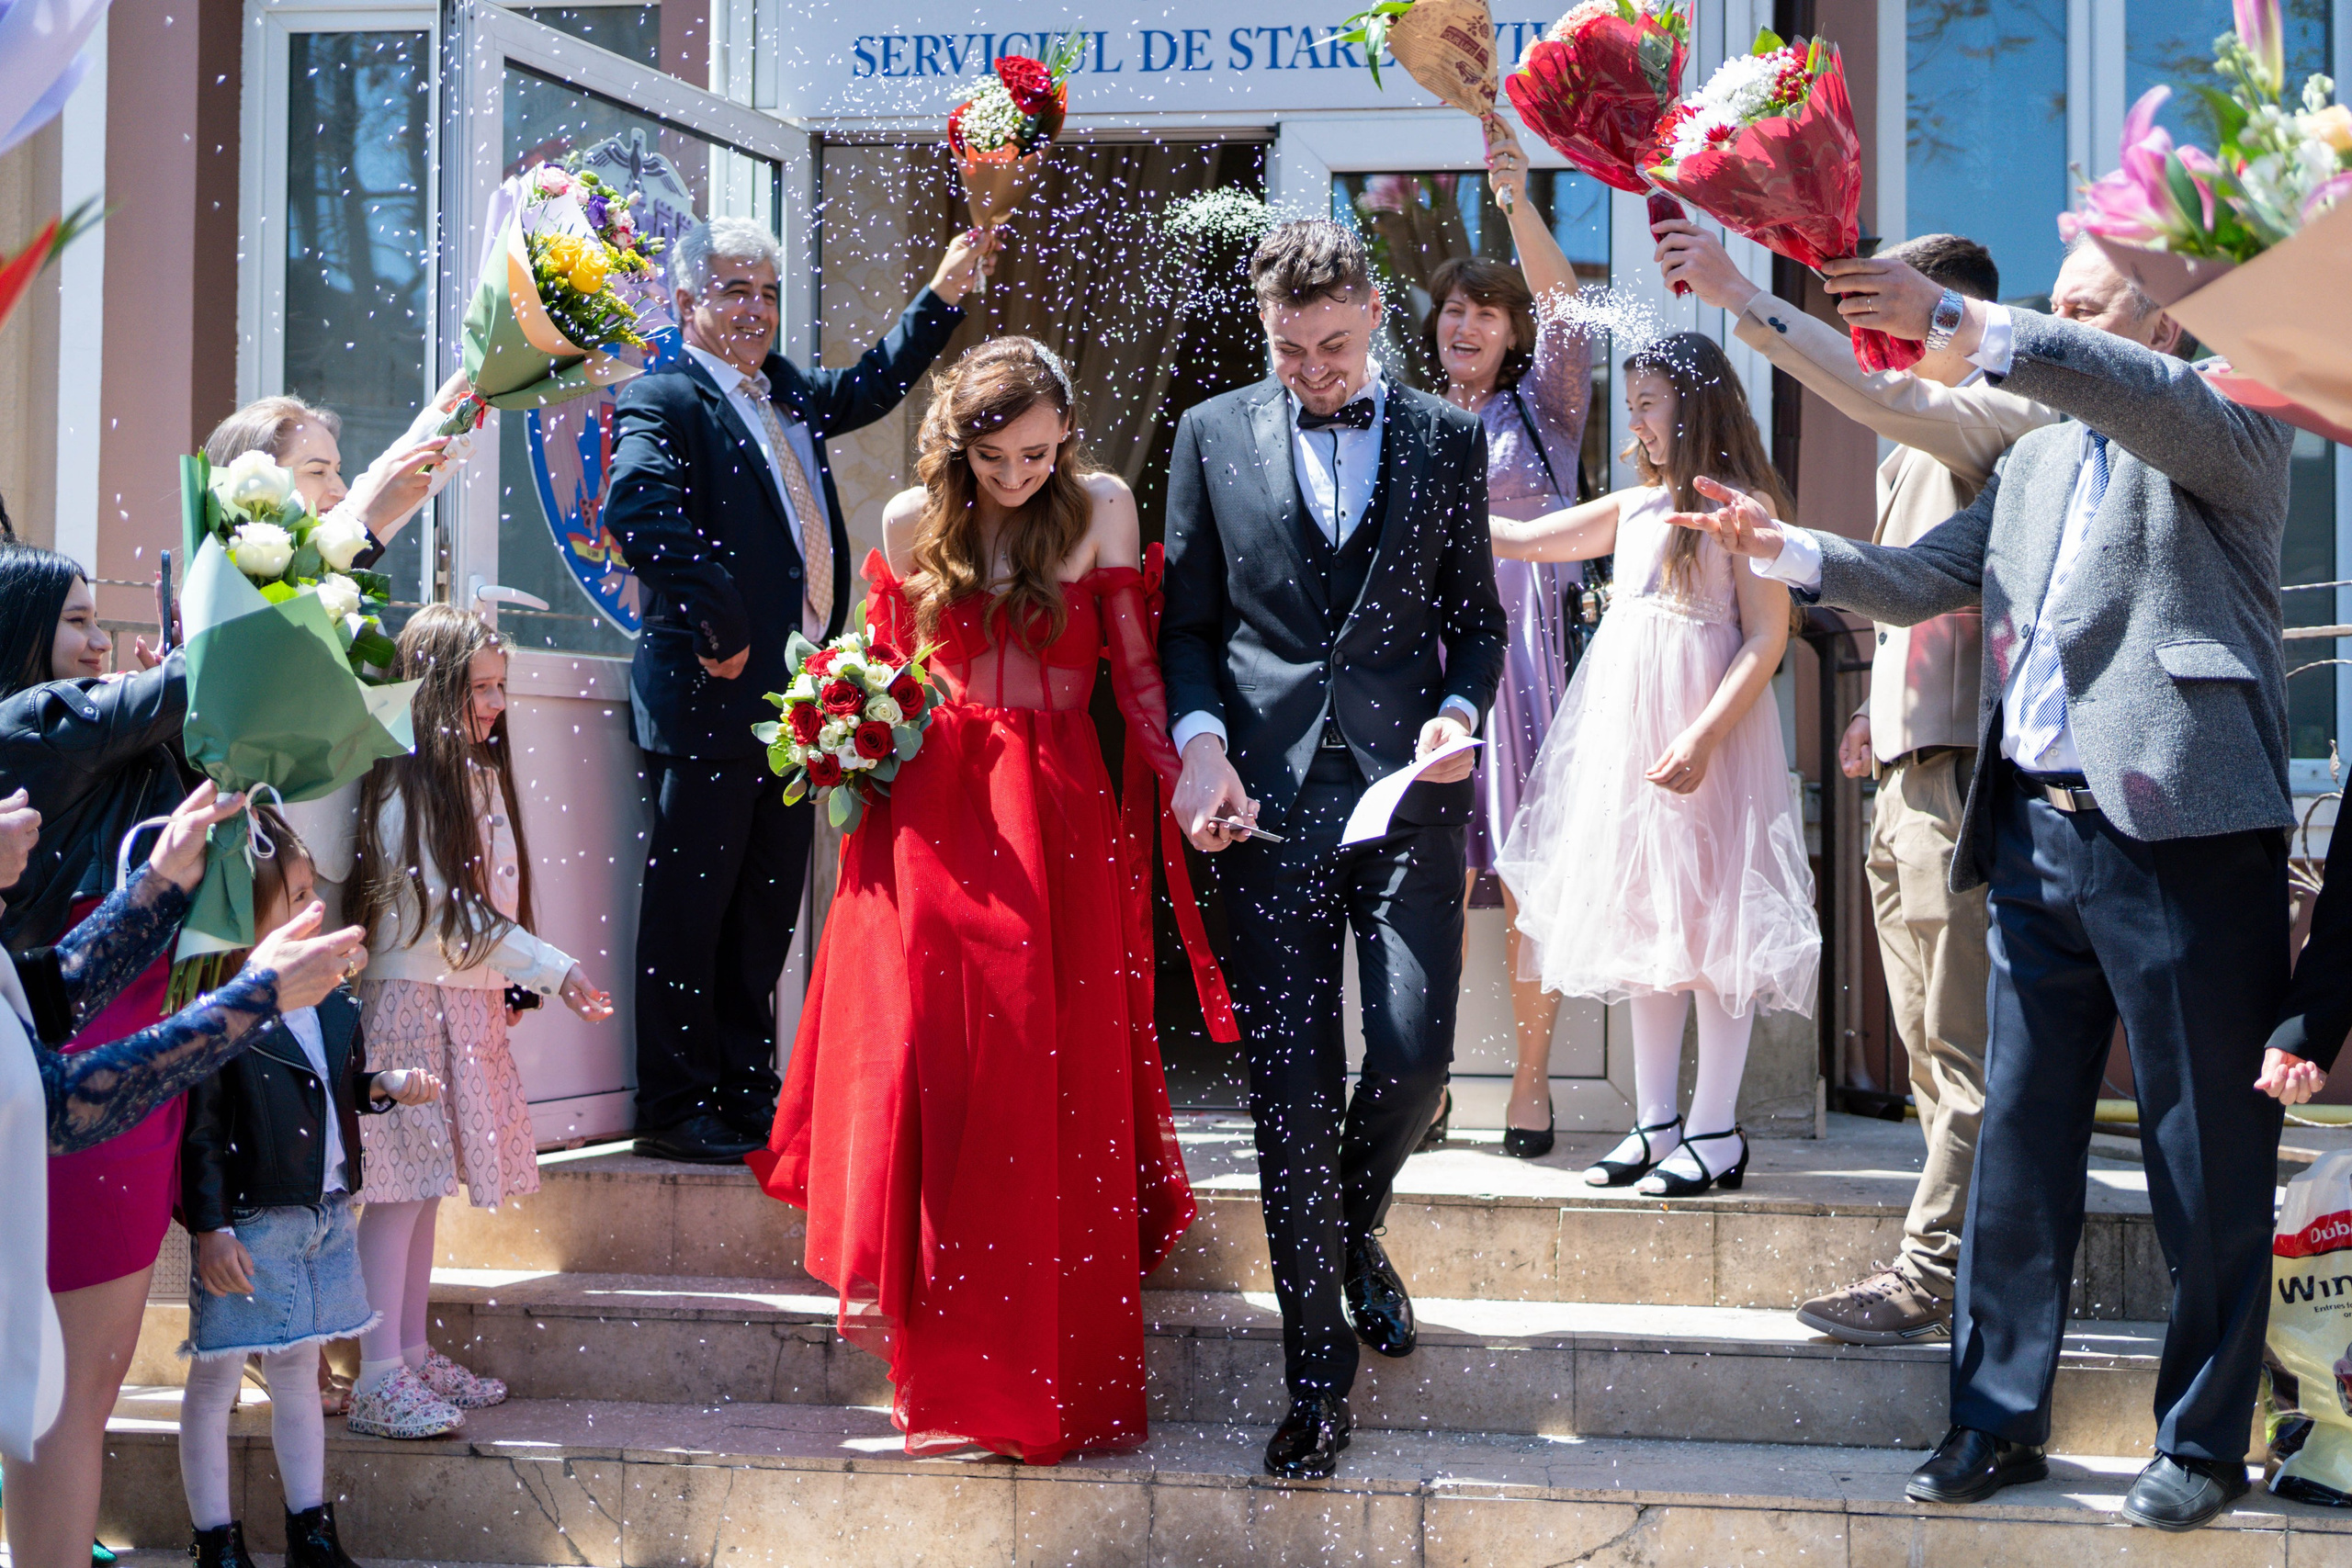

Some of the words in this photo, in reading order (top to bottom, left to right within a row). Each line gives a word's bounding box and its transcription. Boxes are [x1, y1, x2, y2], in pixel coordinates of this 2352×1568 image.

[1137, 28, 1214, 73] DE
[1460, 39, 1476, 56] LIFE
[2311, 1221, 2352, 1244] Dub
[2313, 1303, 2345, 1313] Entries
